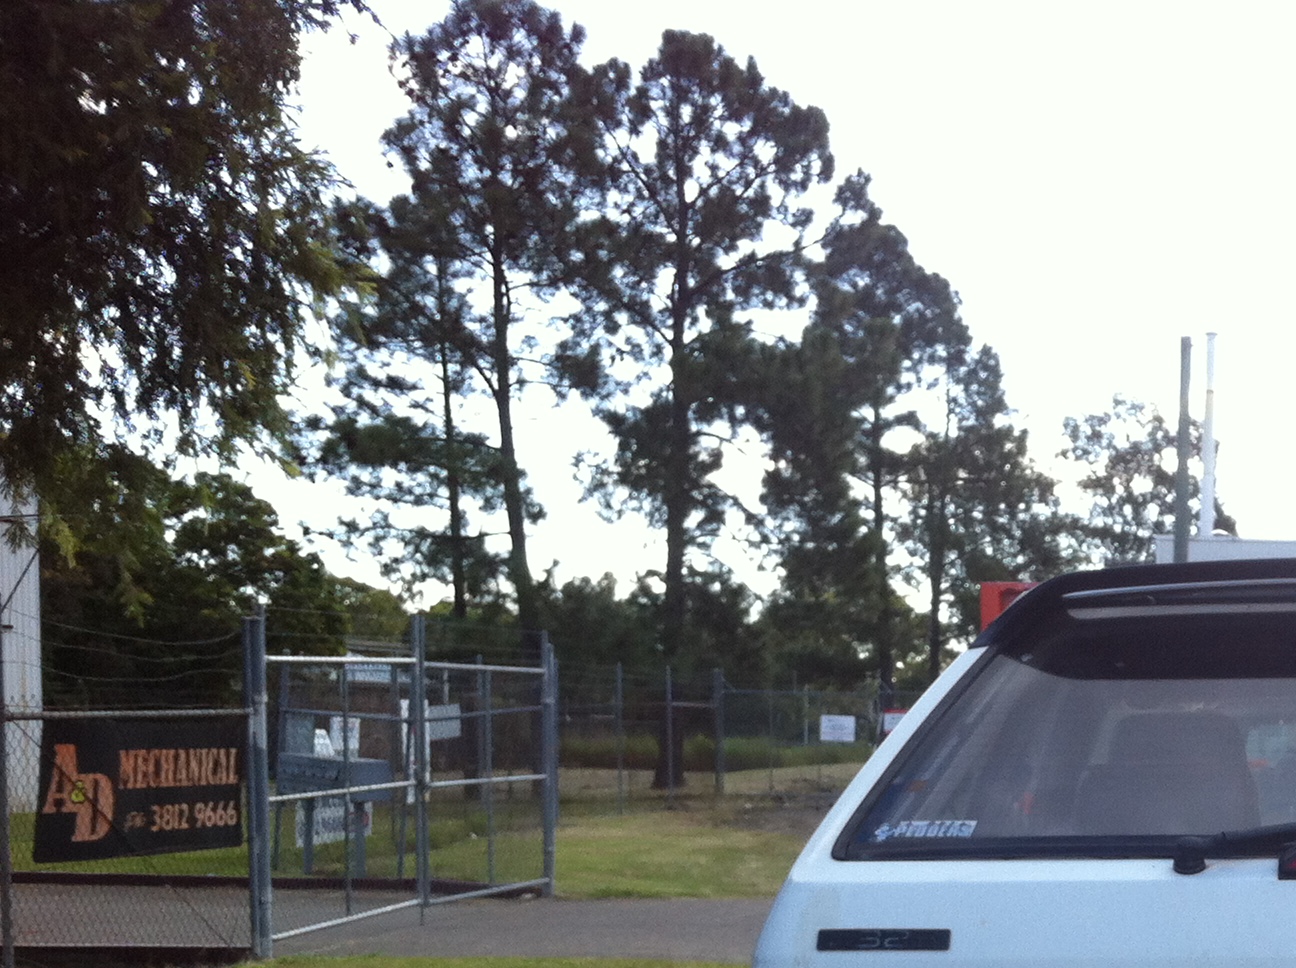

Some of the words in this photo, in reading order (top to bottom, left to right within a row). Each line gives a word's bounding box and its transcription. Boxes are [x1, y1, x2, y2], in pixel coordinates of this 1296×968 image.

[118, 747, 239, 789] MECHANICAL
[150, 803, 190, 832] 3812
[194, 800, 238, 828] 9666
